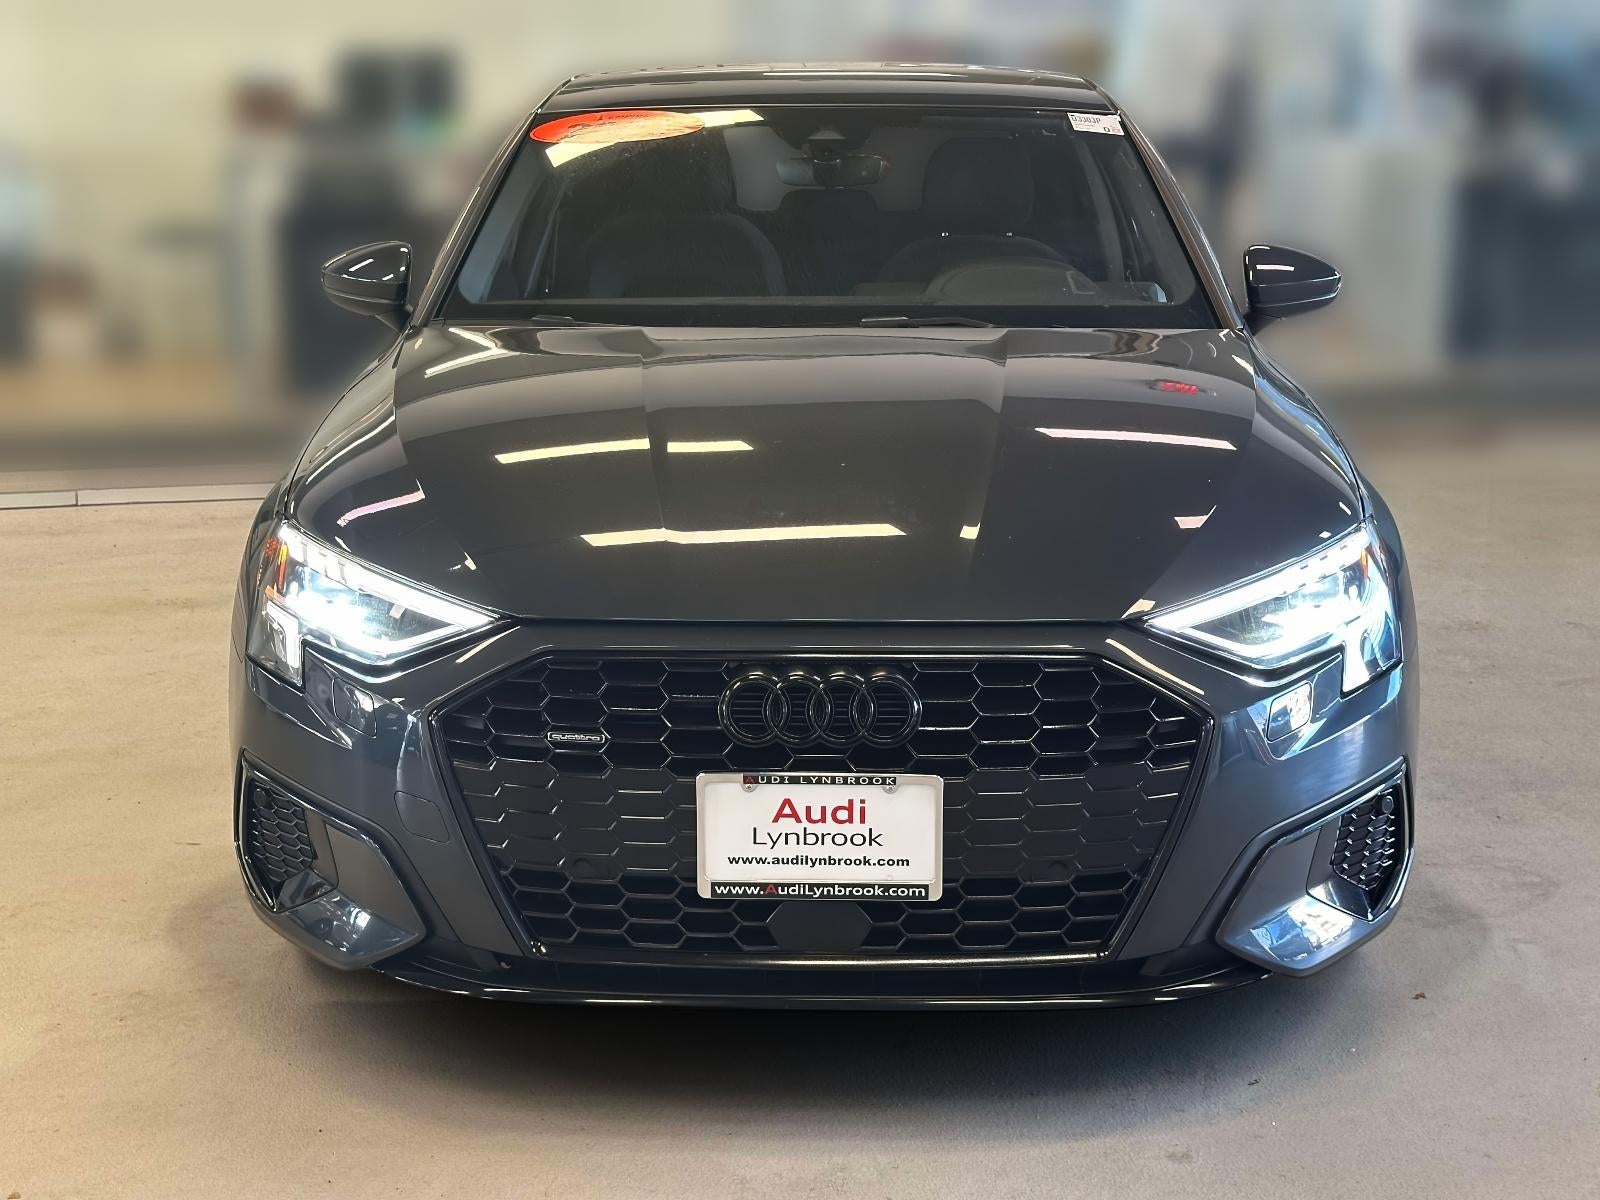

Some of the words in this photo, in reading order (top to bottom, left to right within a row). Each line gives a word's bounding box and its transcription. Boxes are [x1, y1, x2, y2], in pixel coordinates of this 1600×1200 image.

[745, 776, 789, 784] AUDI
[800, 776, 895, 785] LYNBROOK
[771, 798, 866, 825] Audi
[752, 827, 884, 849] Lynbrook
[727, 855, 910, 868] www.audilynbrook.com
[714, 884, 926, 898] www.AudiLynbrook.com
